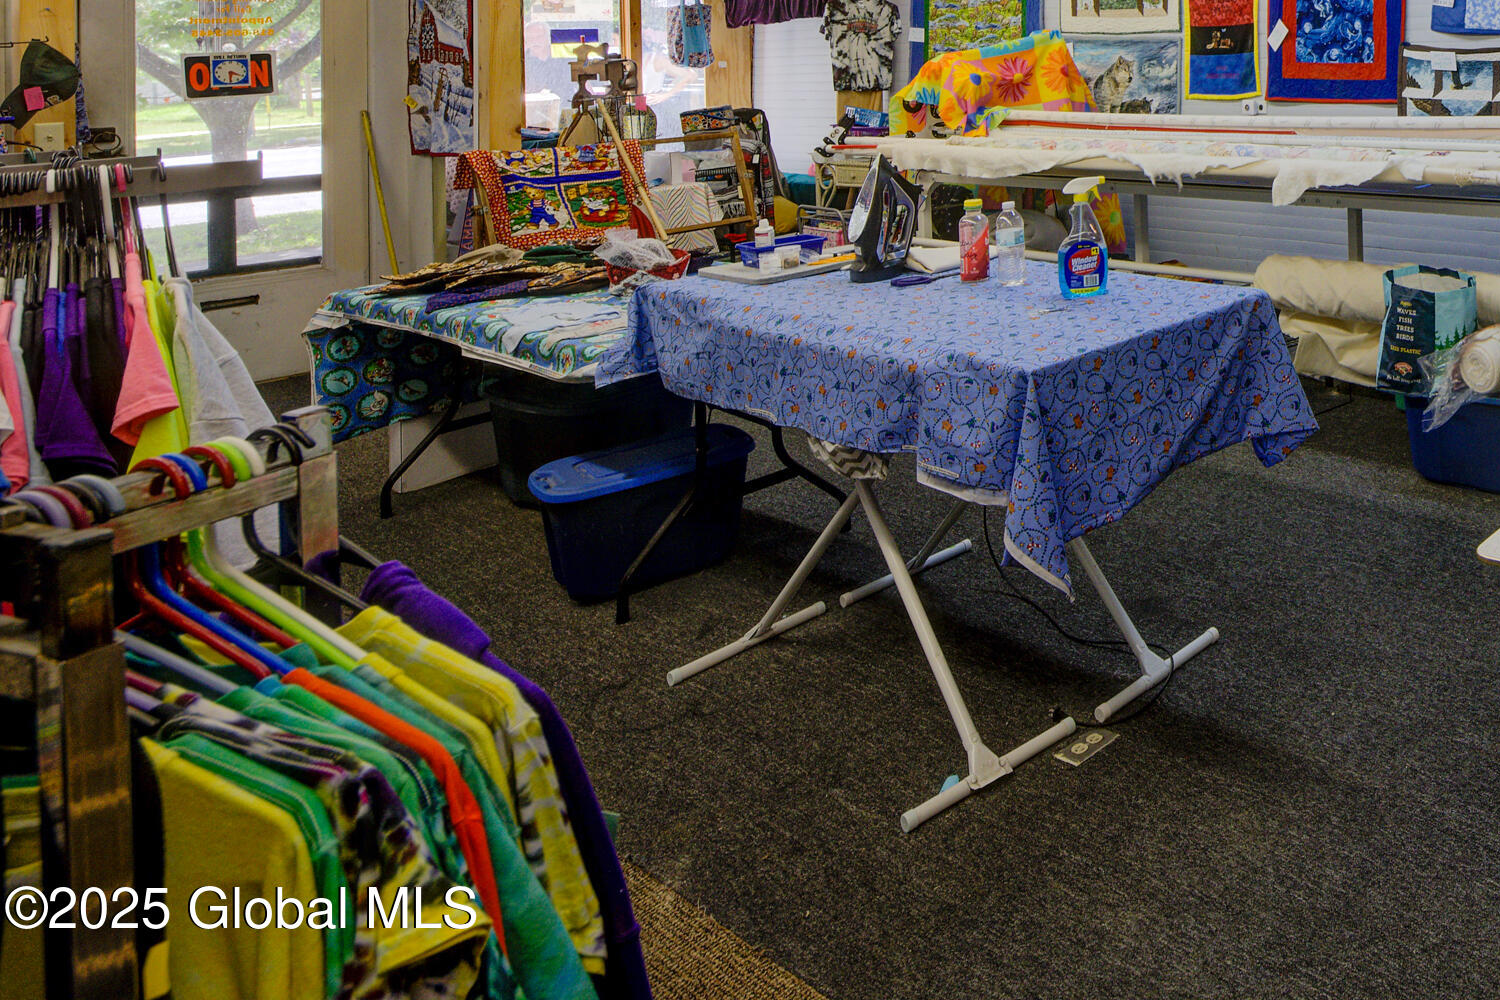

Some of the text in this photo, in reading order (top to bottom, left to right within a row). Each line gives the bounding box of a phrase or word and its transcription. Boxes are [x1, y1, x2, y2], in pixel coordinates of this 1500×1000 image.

[189, 60, 270, 92] ON
[1071, 255, 1098, 265] Window
[1071, 262, 1097, 272] Cleaner
[1397, 307, 1417, 316] WAVES
[1398, 316, 1413, 325] FISH
[1396, 324, 1415, 334] TREES
[1395, 332, 1415, 342] BIRDS
[1400, 346, 1422, 355] PLASTIC
